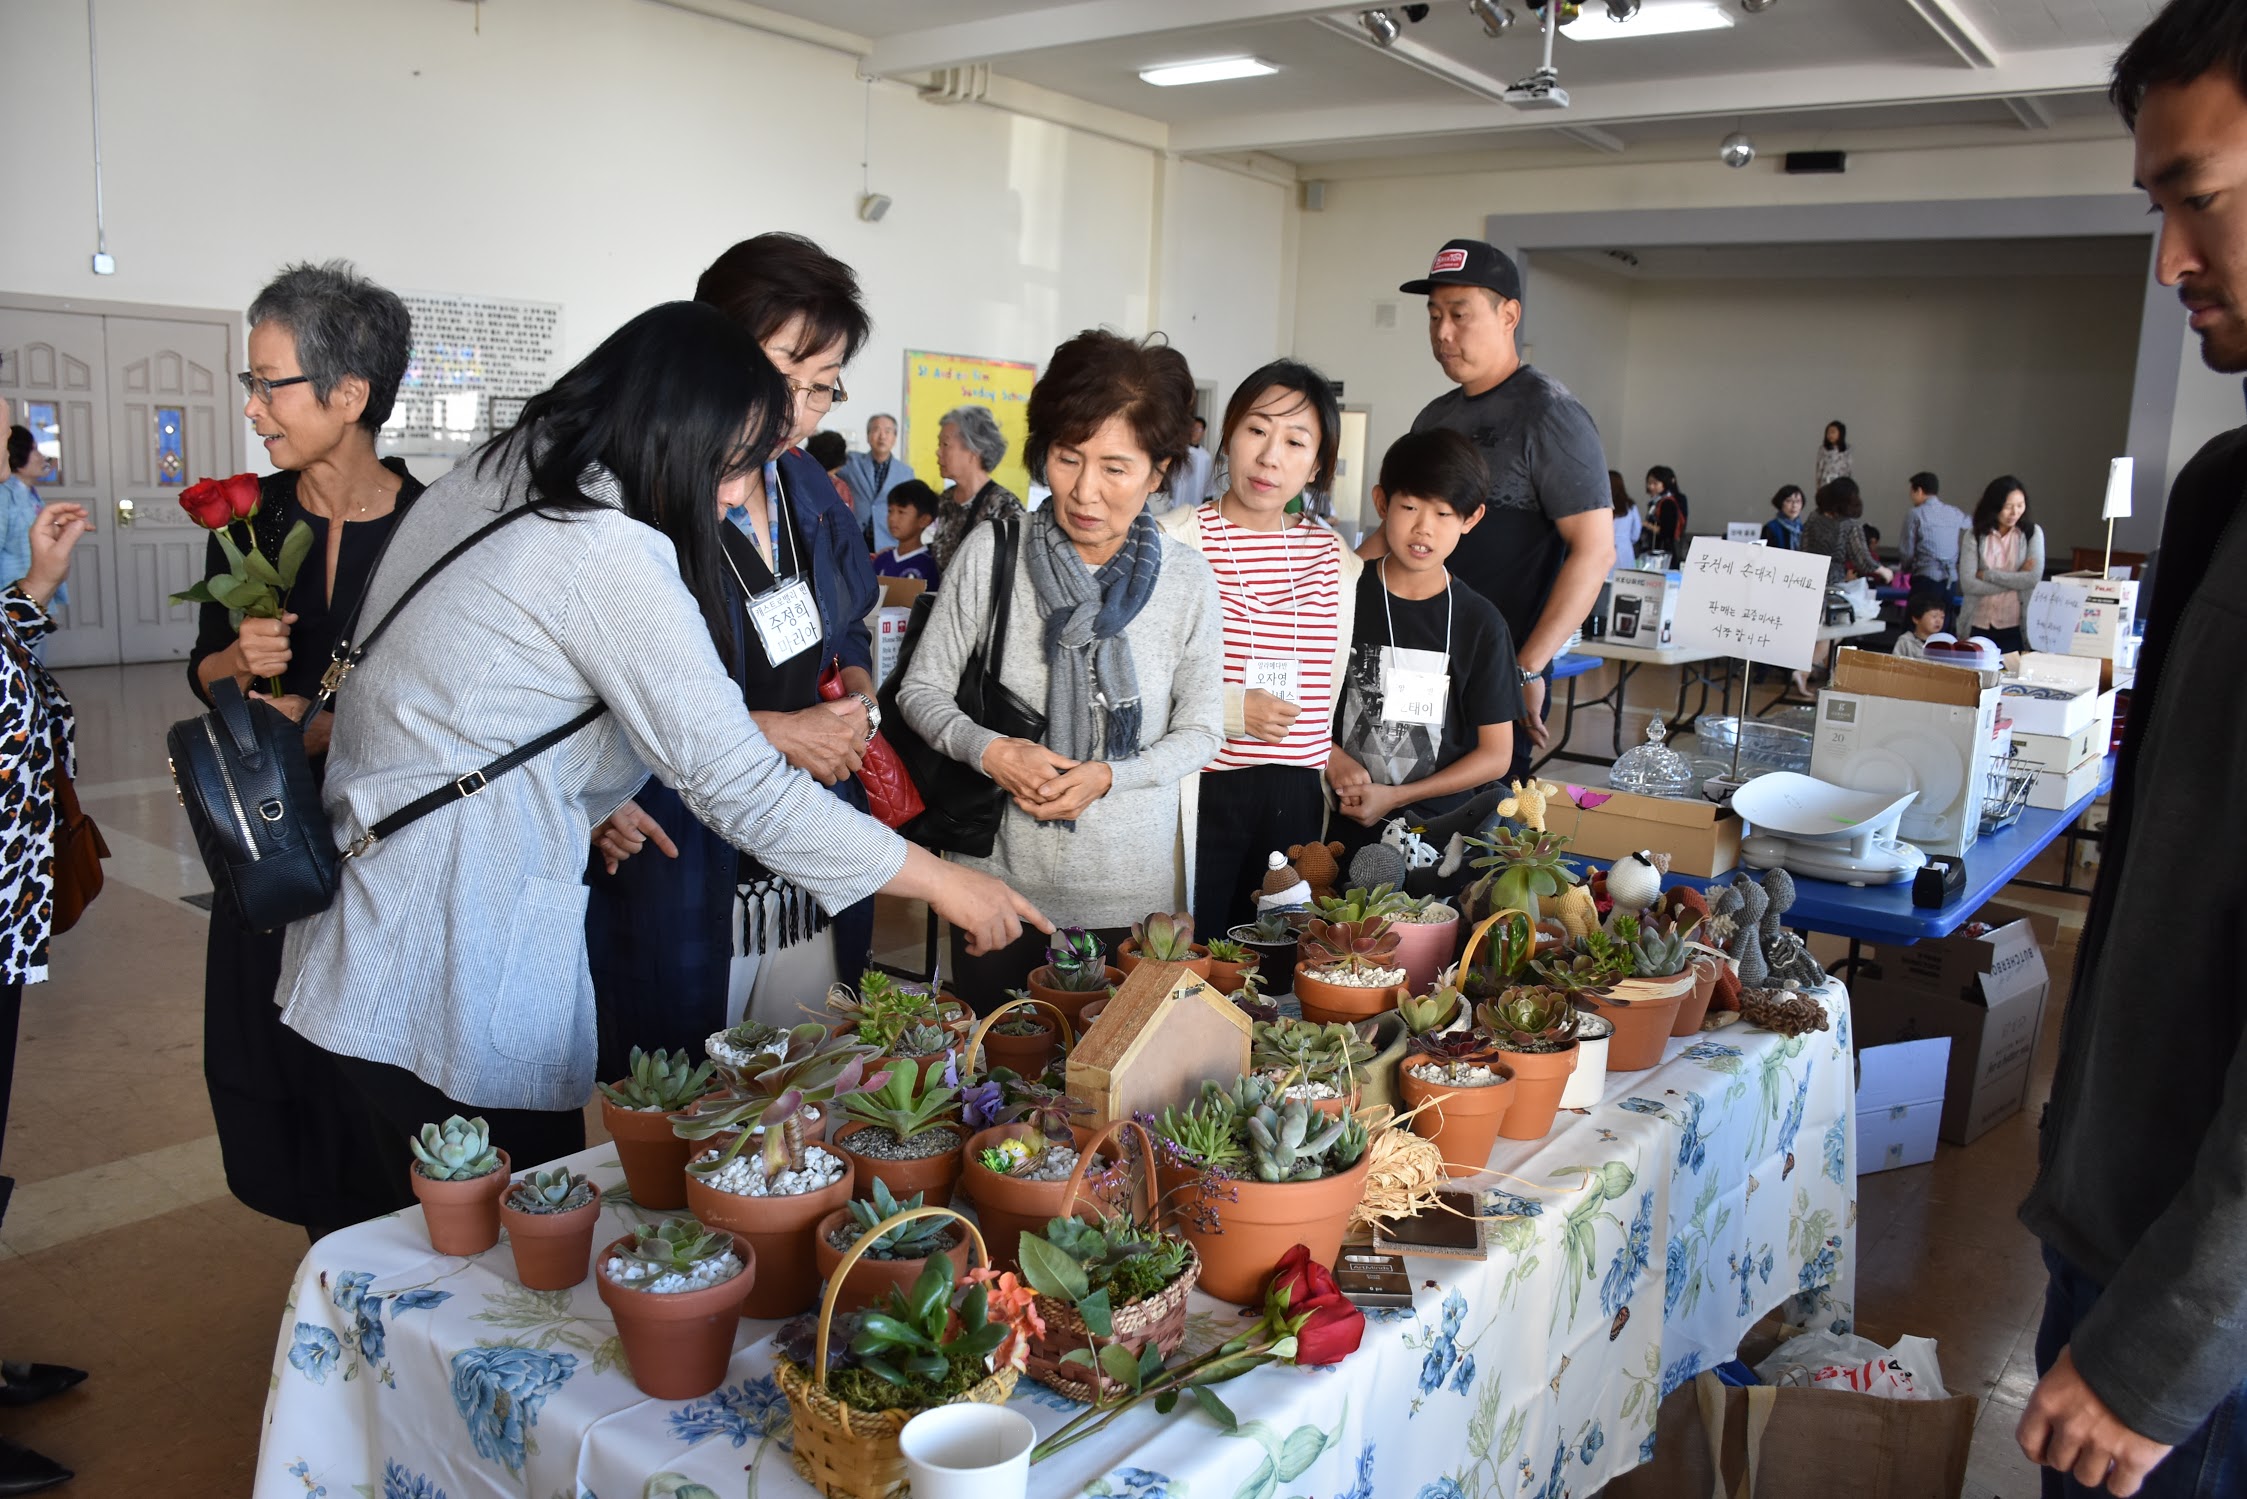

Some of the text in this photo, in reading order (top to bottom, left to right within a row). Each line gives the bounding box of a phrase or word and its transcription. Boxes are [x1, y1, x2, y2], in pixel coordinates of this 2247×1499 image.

[961, 386, 995, 402] Sunday
[1694, 553, 1816, 591] 물건에 손대지 마세요
[1615, 576, 1646, 586] KEURIG
[1708, 600, 1736, 617] 판매는
[769, 600, 811, 634] 주정희
[778, 621, 818, 654] 마리아
[1255, 672, 1287, 687] 오자영
[1831, 732, 1845, 743] 20
